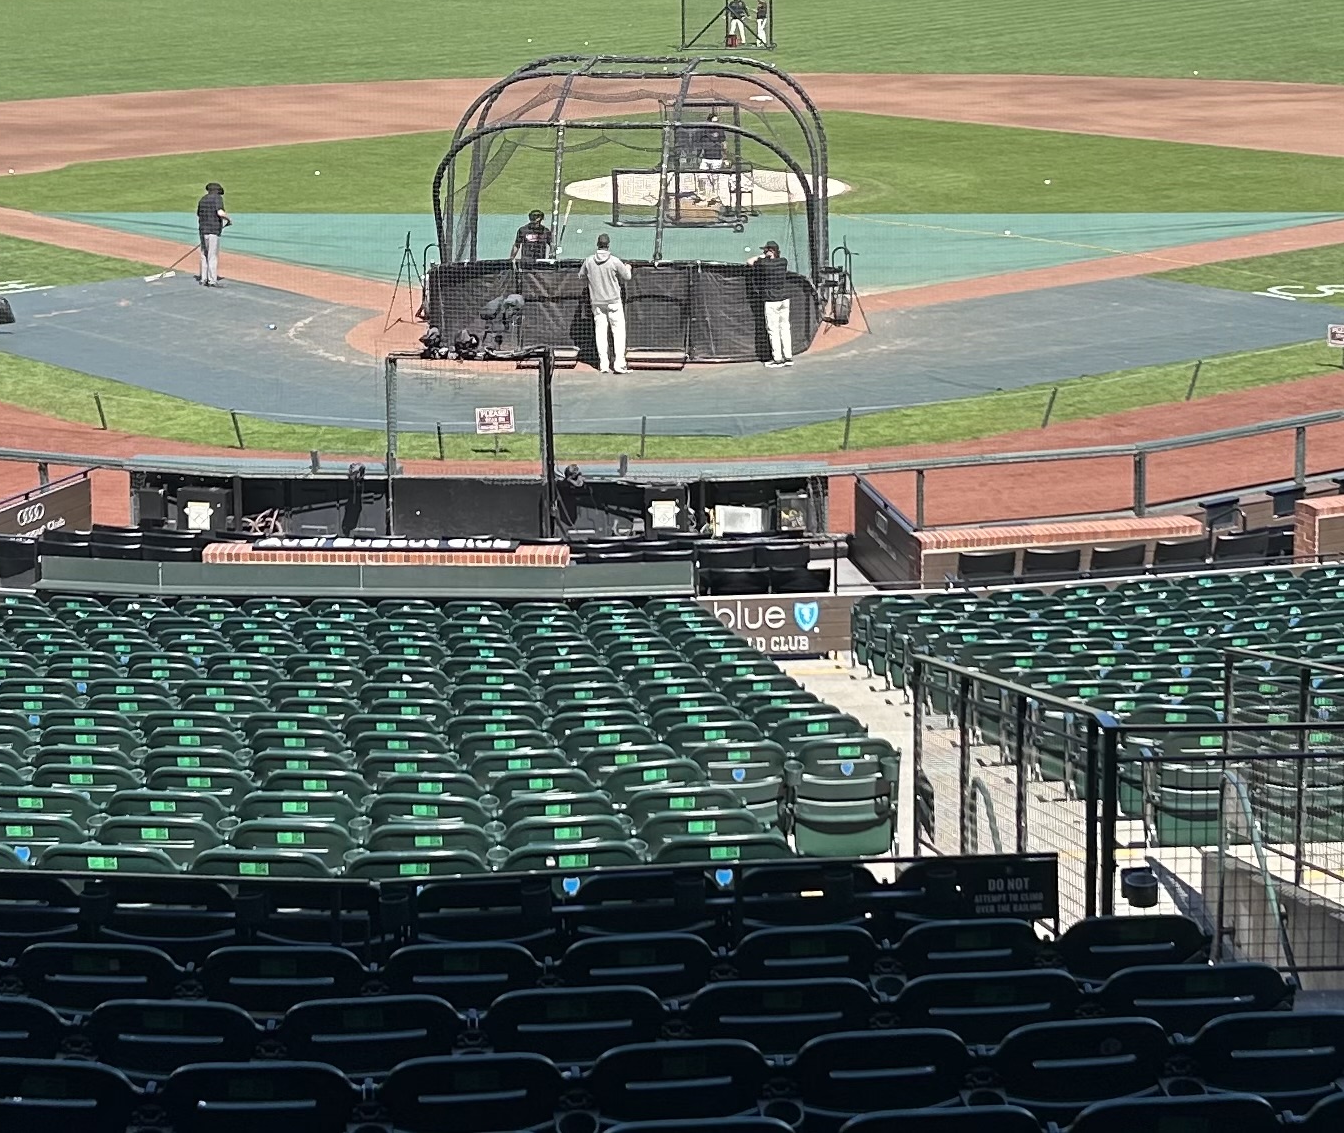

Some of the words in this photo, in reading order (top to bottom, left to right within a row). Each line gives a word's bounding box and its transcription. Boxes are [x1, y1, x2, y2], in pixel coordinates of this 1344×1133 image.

[713, 600, 786, 630] blue
[770, 635, 810, 652] CLUB
[988, 878, 1004, 892] DO
[1007, 877, 1031, 891] NOT
[974, 893, 1007, 904] ATTEMPT
[1008, 893, 1019, 903] TO
[975, 903, 996, 914] OVER
[997, 903, 1011, 913] THE
